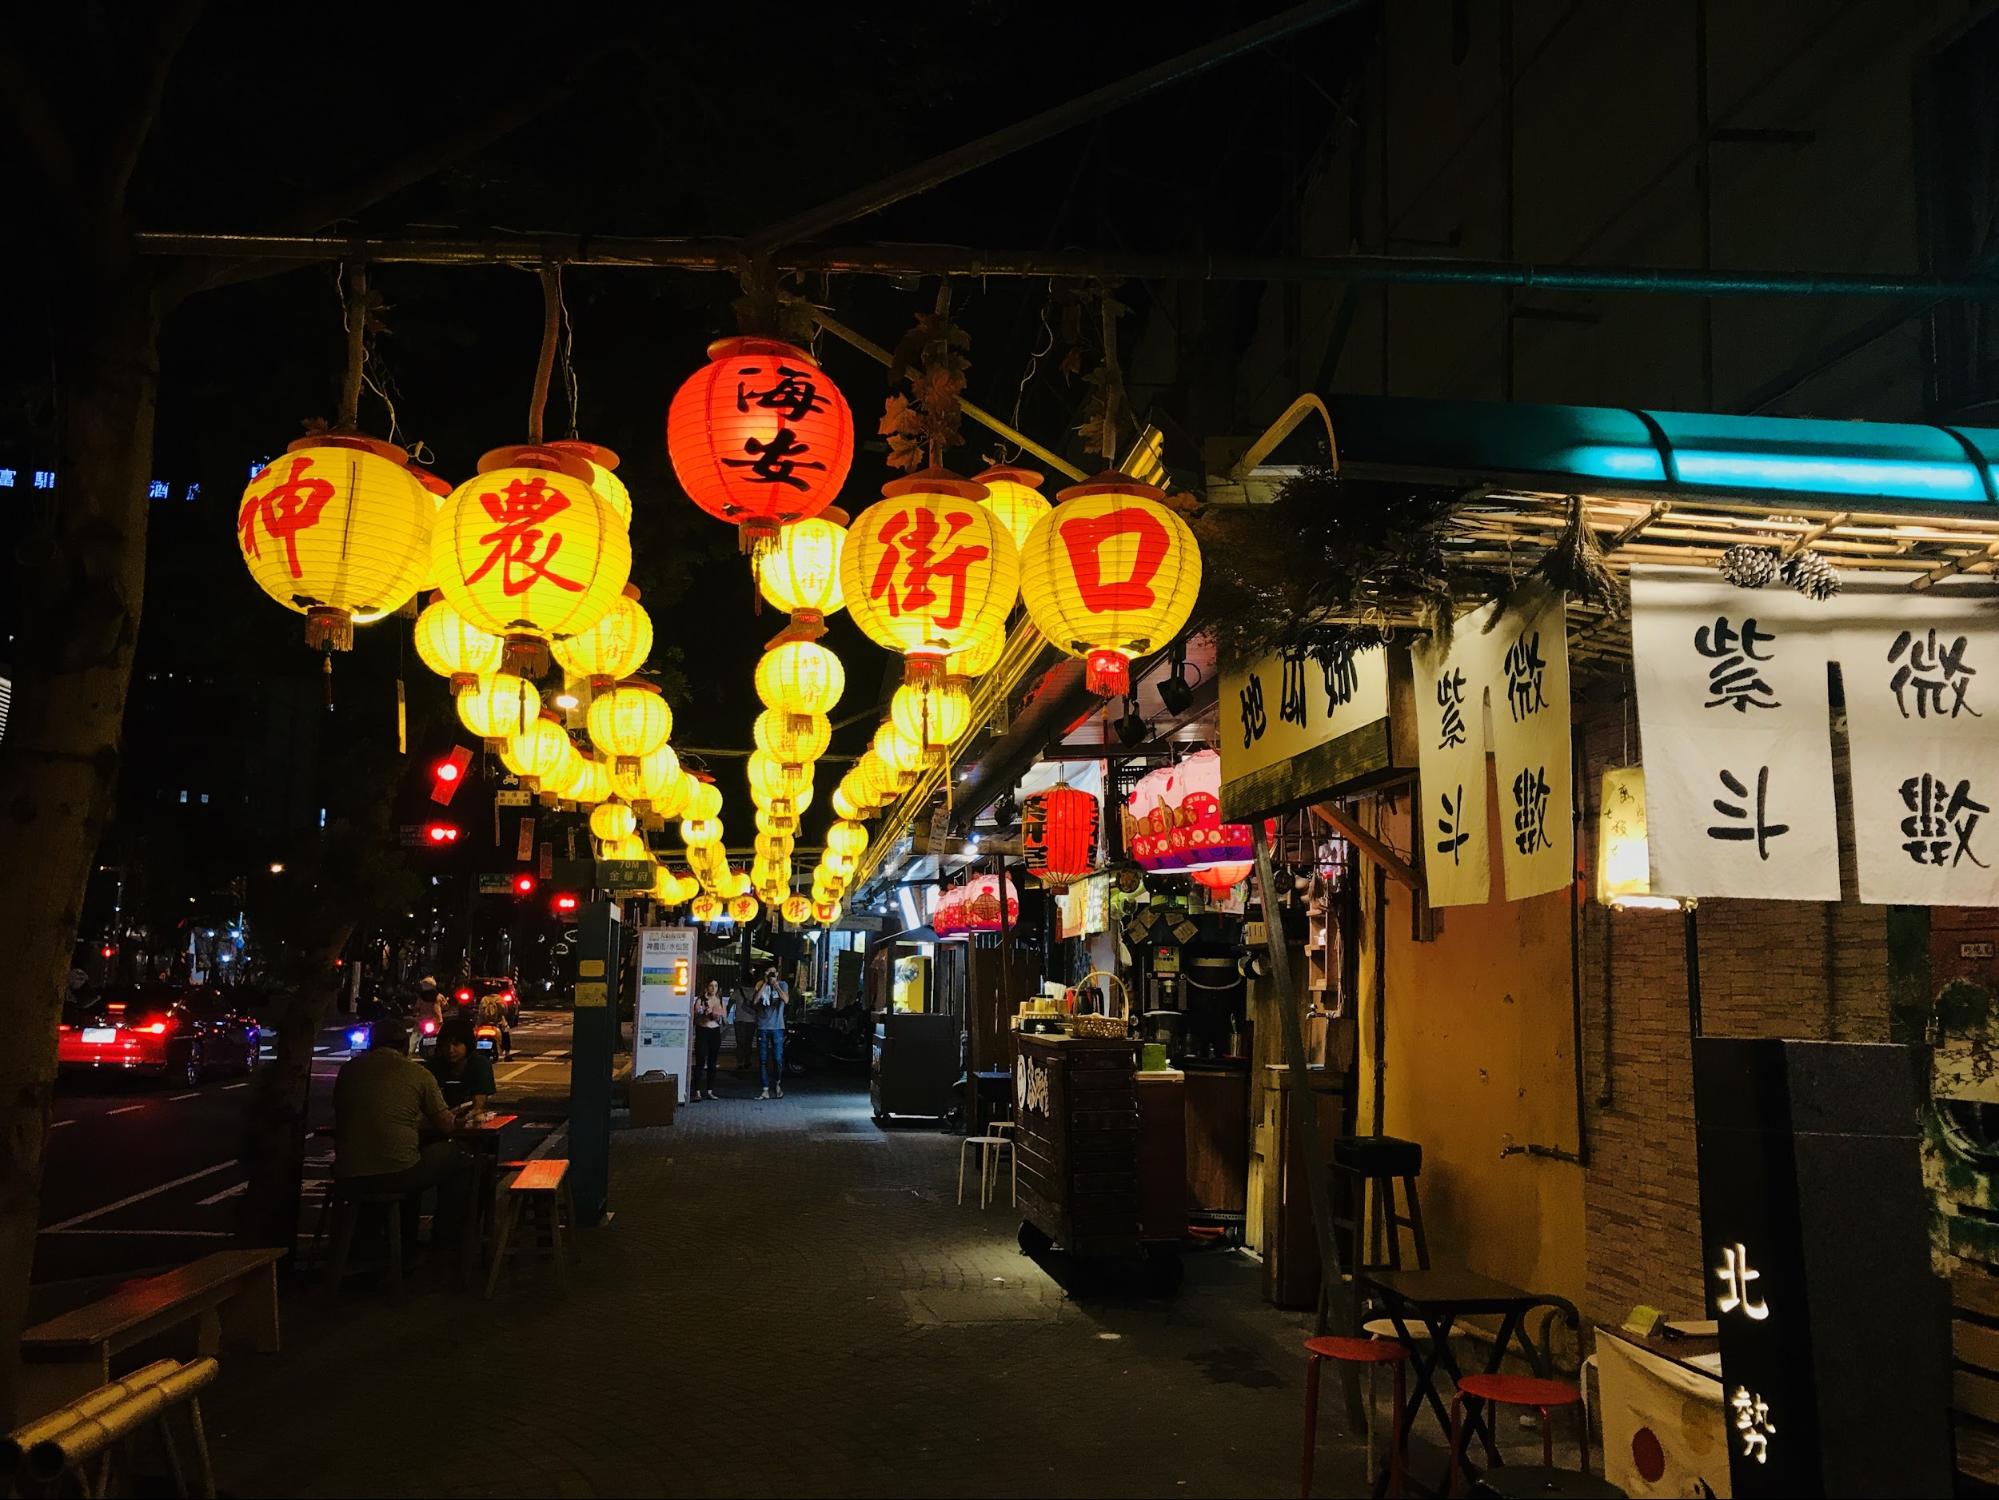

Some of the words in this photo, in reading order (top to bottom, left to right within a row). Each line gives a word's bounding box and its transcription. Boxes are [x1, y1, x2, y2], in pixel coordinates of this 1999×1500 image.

[721, 365, 831, 492] 海安
[237, 456, 337, 580] 神
[464, 478, 586, 597] 農
[870, 508, 990, 630] 街
[1058, 507, 1171, 614] 口
[1718, 1243, 1777, 1465] 北勢
